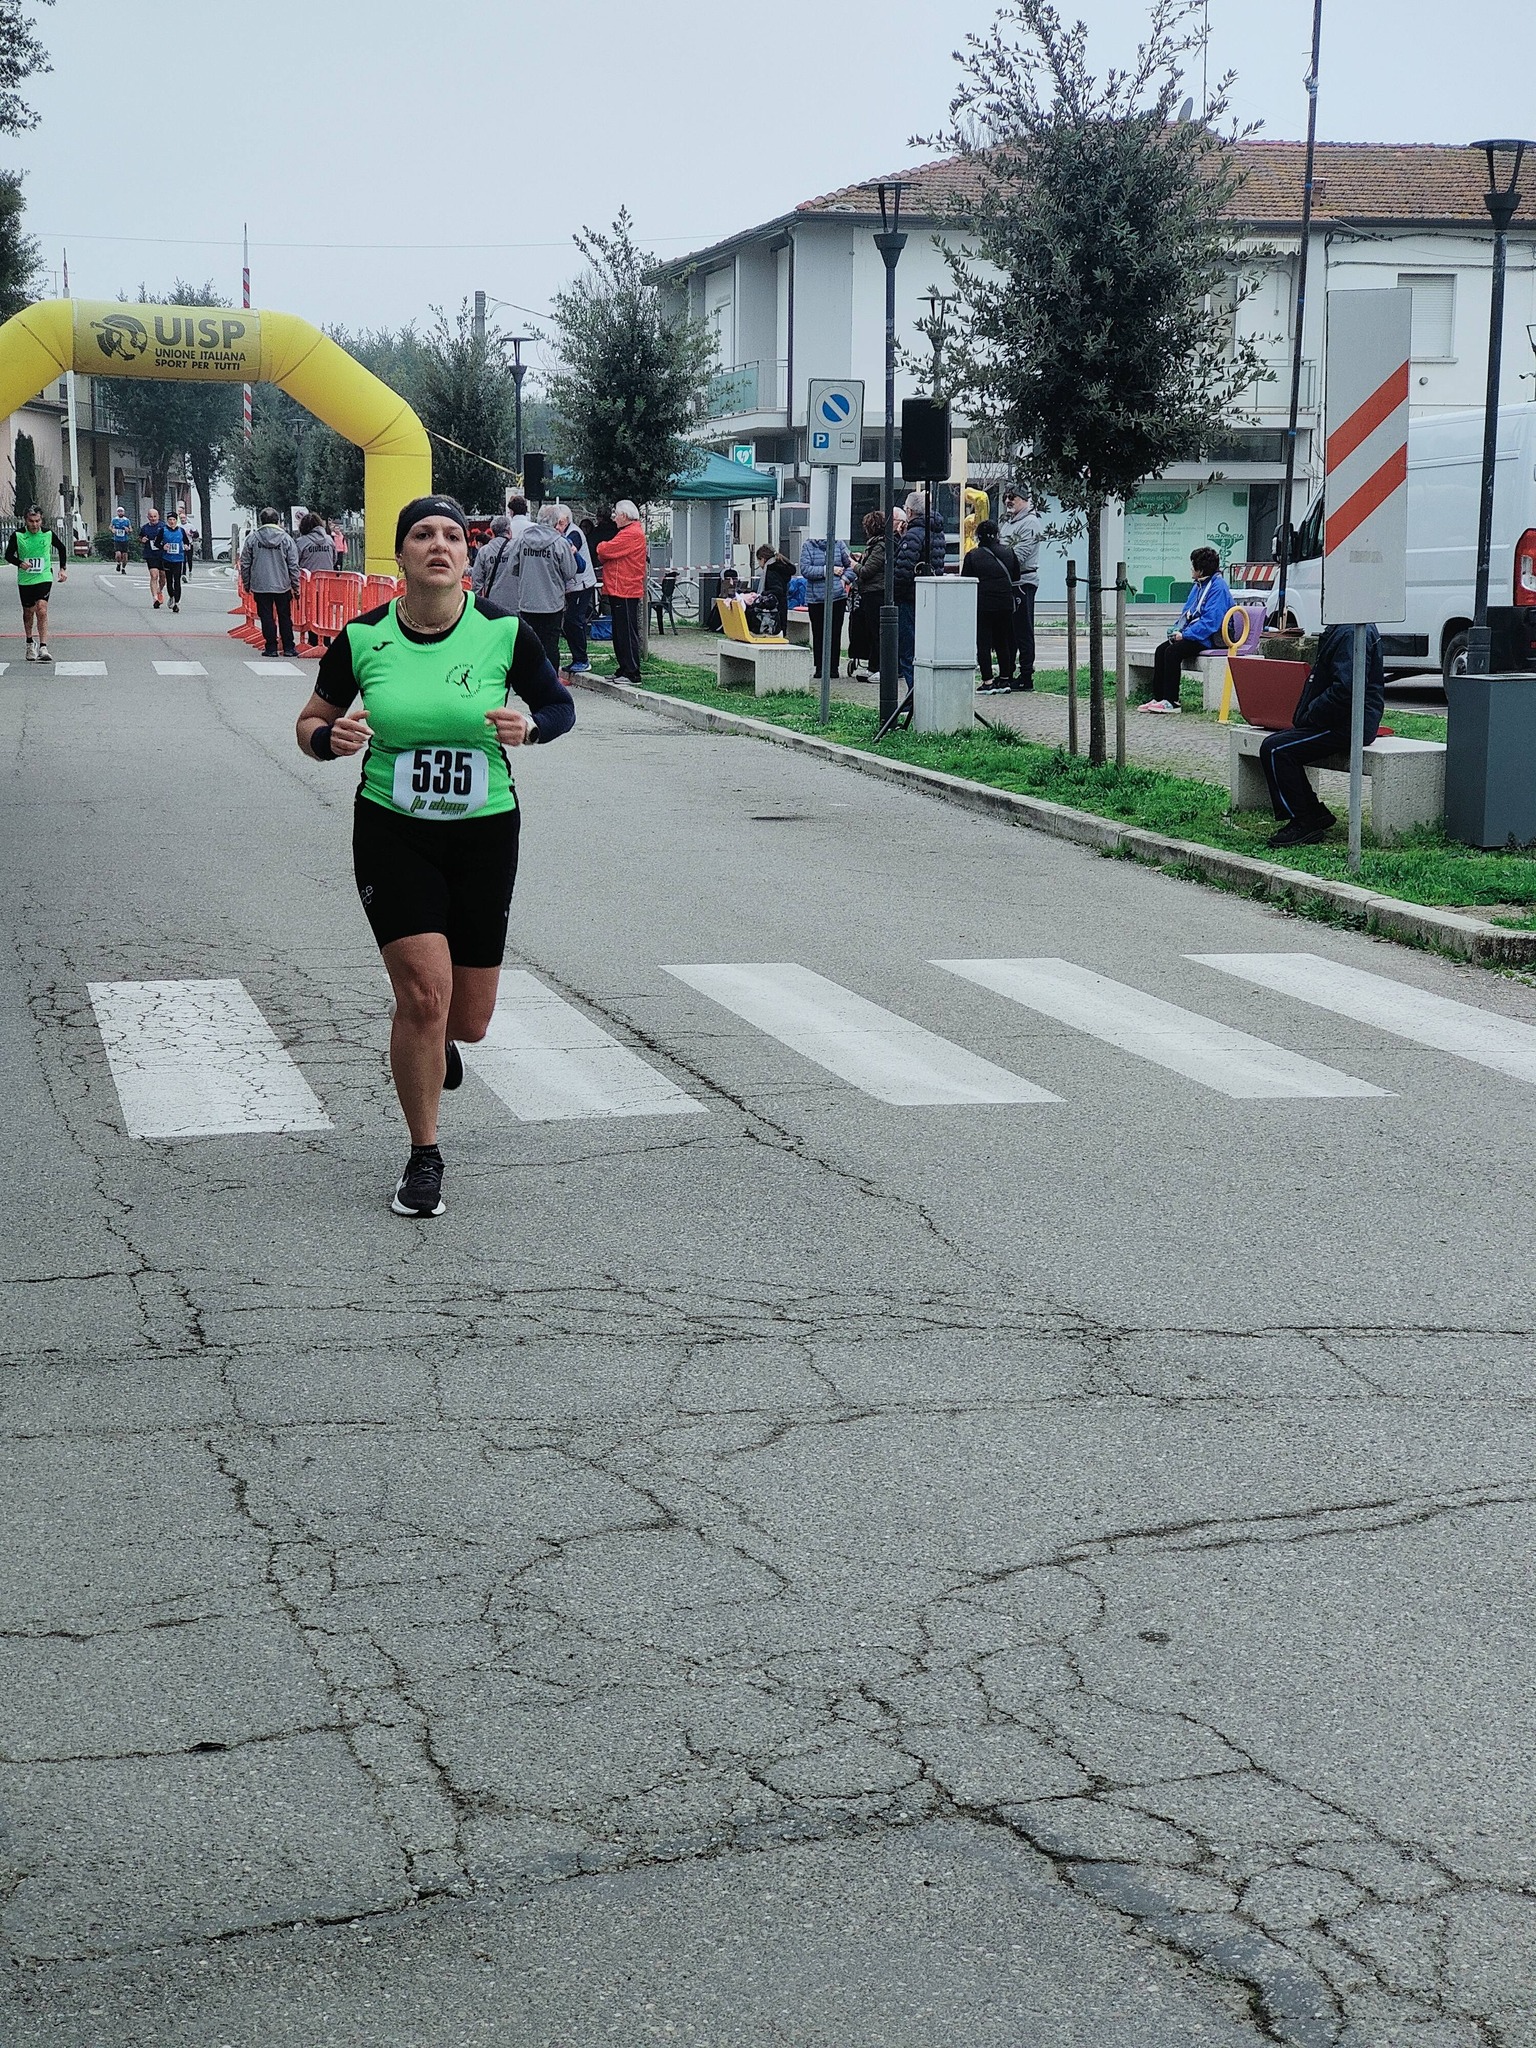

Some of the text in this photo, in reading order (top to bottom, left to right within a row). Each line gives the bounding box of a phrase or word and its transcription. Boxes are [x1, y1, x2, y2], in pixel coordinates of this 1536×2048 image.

[154, 316, 246, 349] UISP
[155, 348, 246, 361] UNIONE ITALIANA
[155, 359, 240, 370] SPORT PER TUTTI
[815, 433, 827, 447] P
[523, 547, 551, 558] GIUDICE
[412, 749, 472, 796] 535
